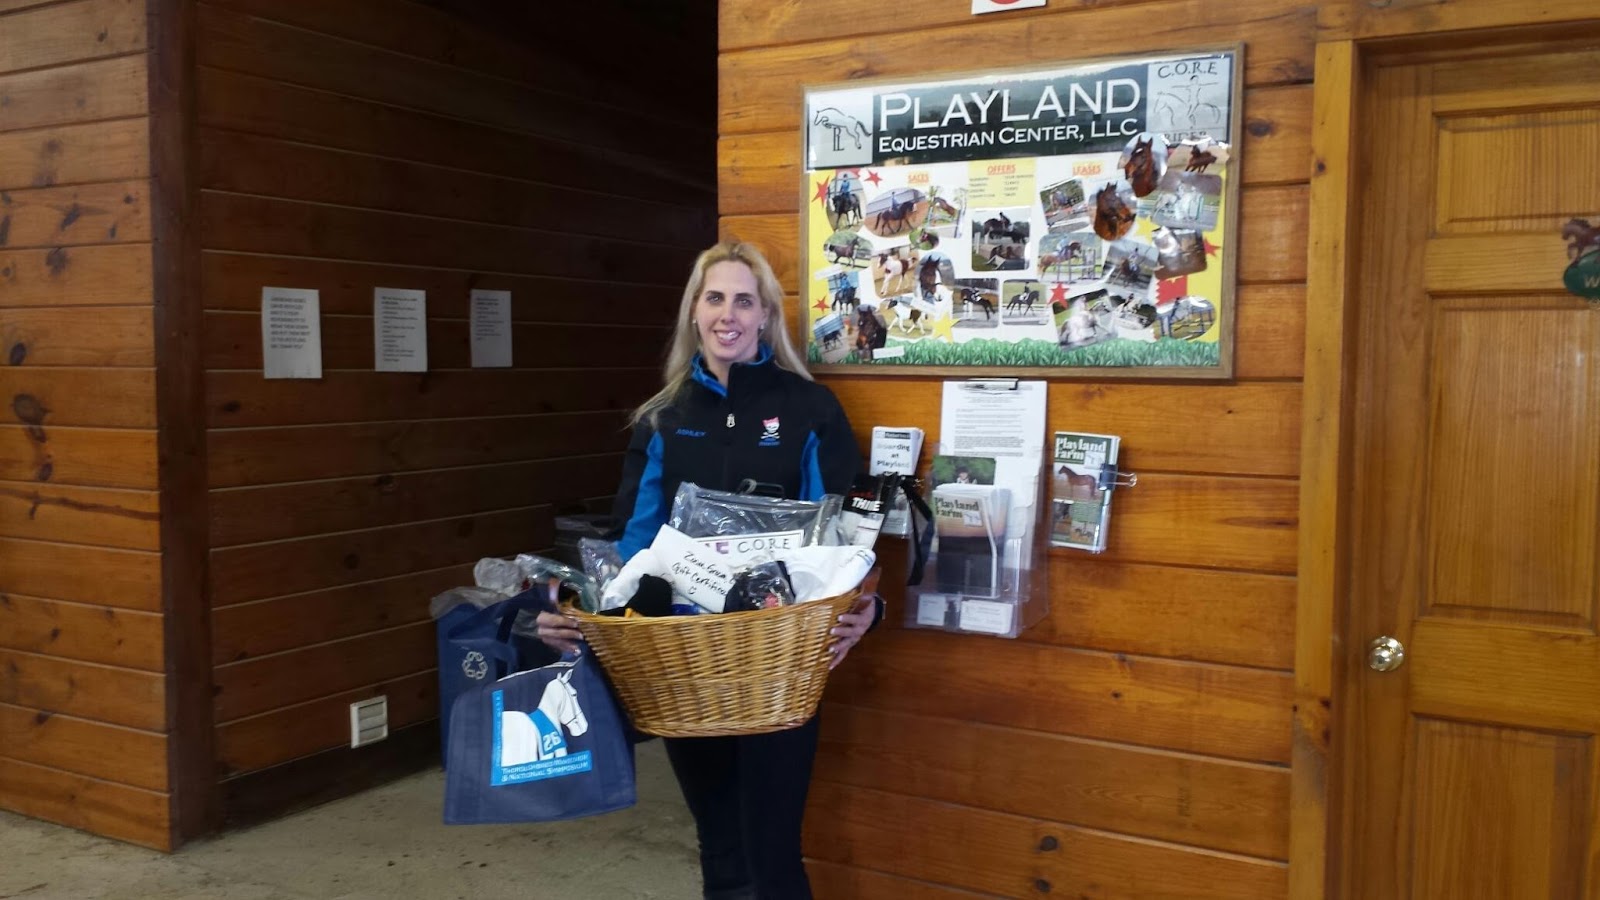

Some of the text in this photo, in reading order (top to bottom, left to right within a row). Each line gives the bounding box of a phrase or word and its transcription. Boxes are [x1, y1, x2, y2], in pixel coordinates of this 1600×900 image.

[879, 78, 1141, 132] PLAYLAND
[878, 118, 1139, 153] EQUESTRIAN CENTER, LLC
[987, 164, 1016, 174] OFFERS
[1072, 165, 1102, 175] LEASES
[1055, 437, 1107, 453] Playland
[1055, 449, 1084, 460] Farm
[934, 497, 980, 511] Playland
[936, 509, 963, 518] Farm
[543, 731, 561, 751] 26
